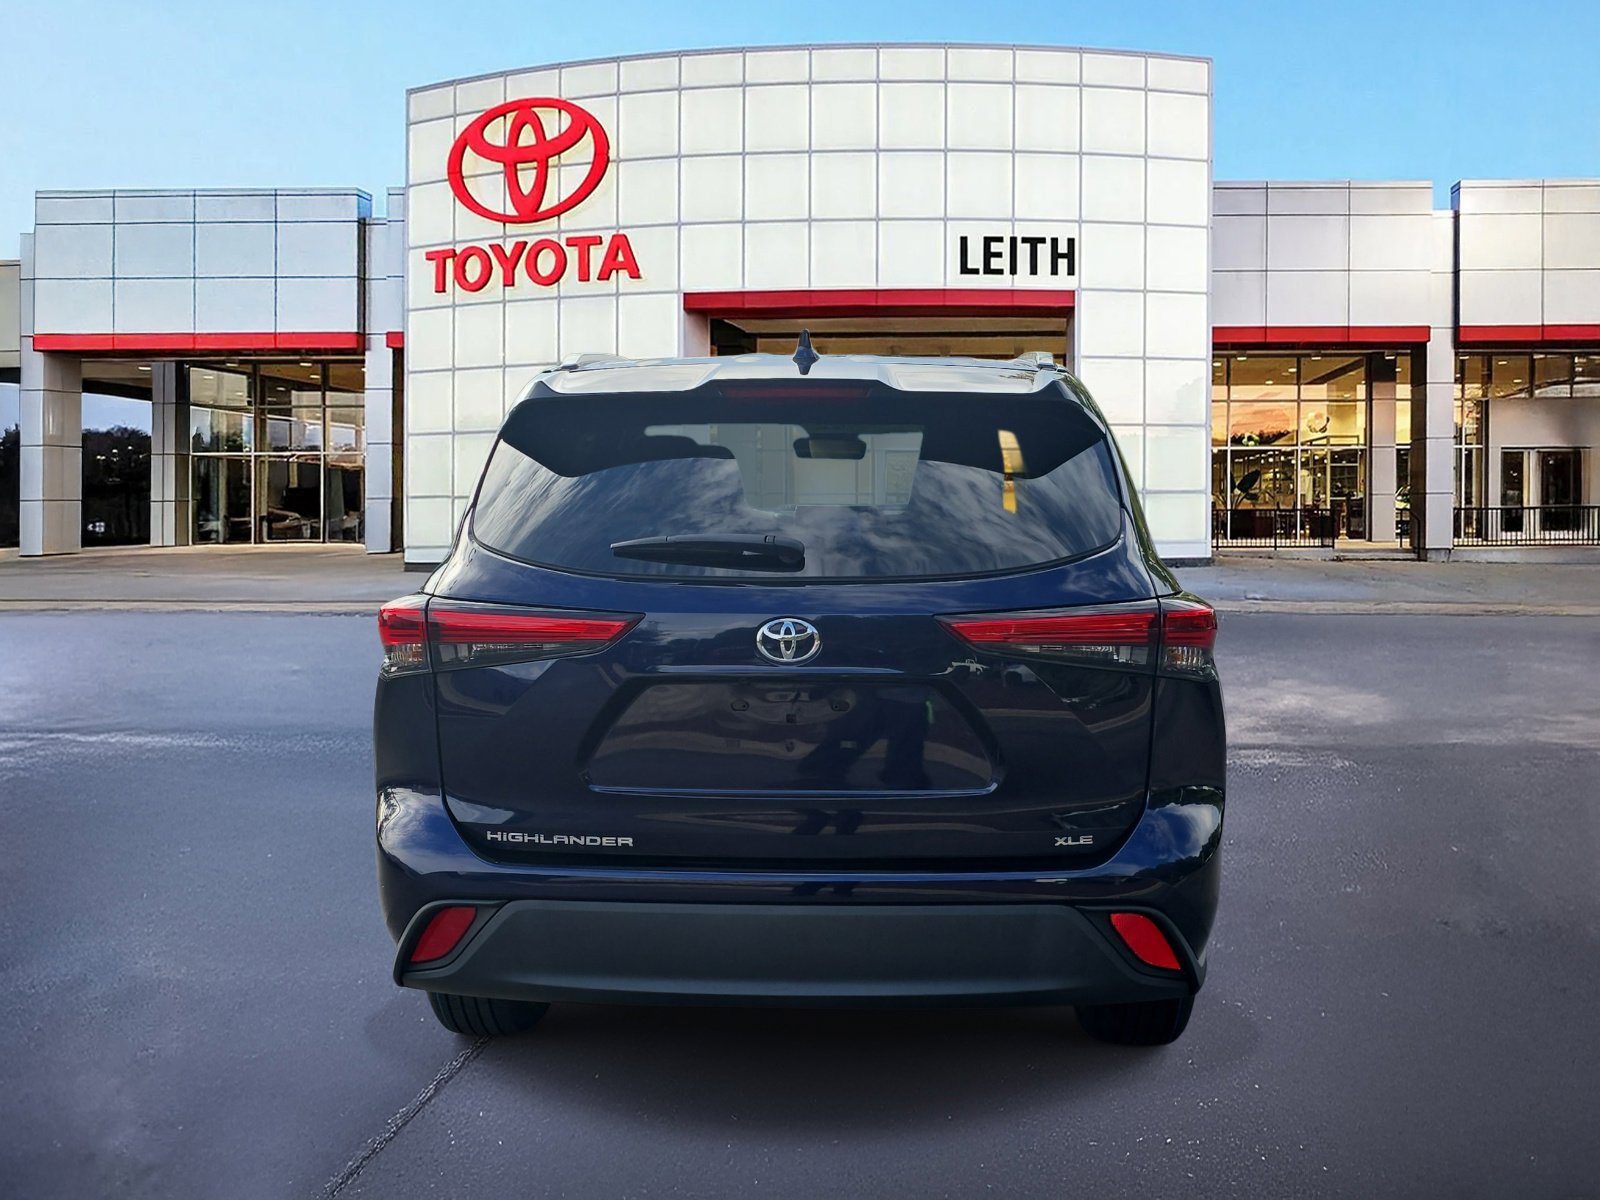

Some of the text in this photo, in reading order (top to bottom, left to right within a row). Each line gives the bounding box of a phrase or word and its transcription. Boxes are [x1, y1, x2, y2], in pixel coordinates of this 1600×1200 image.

[425, 234, 642, 293] TOYOTA
[960, 236, 1075, 276] LEITH
[486, 830, 634, 847] HIGHLANDER
[1054, 835, 1094, 846] XLE
